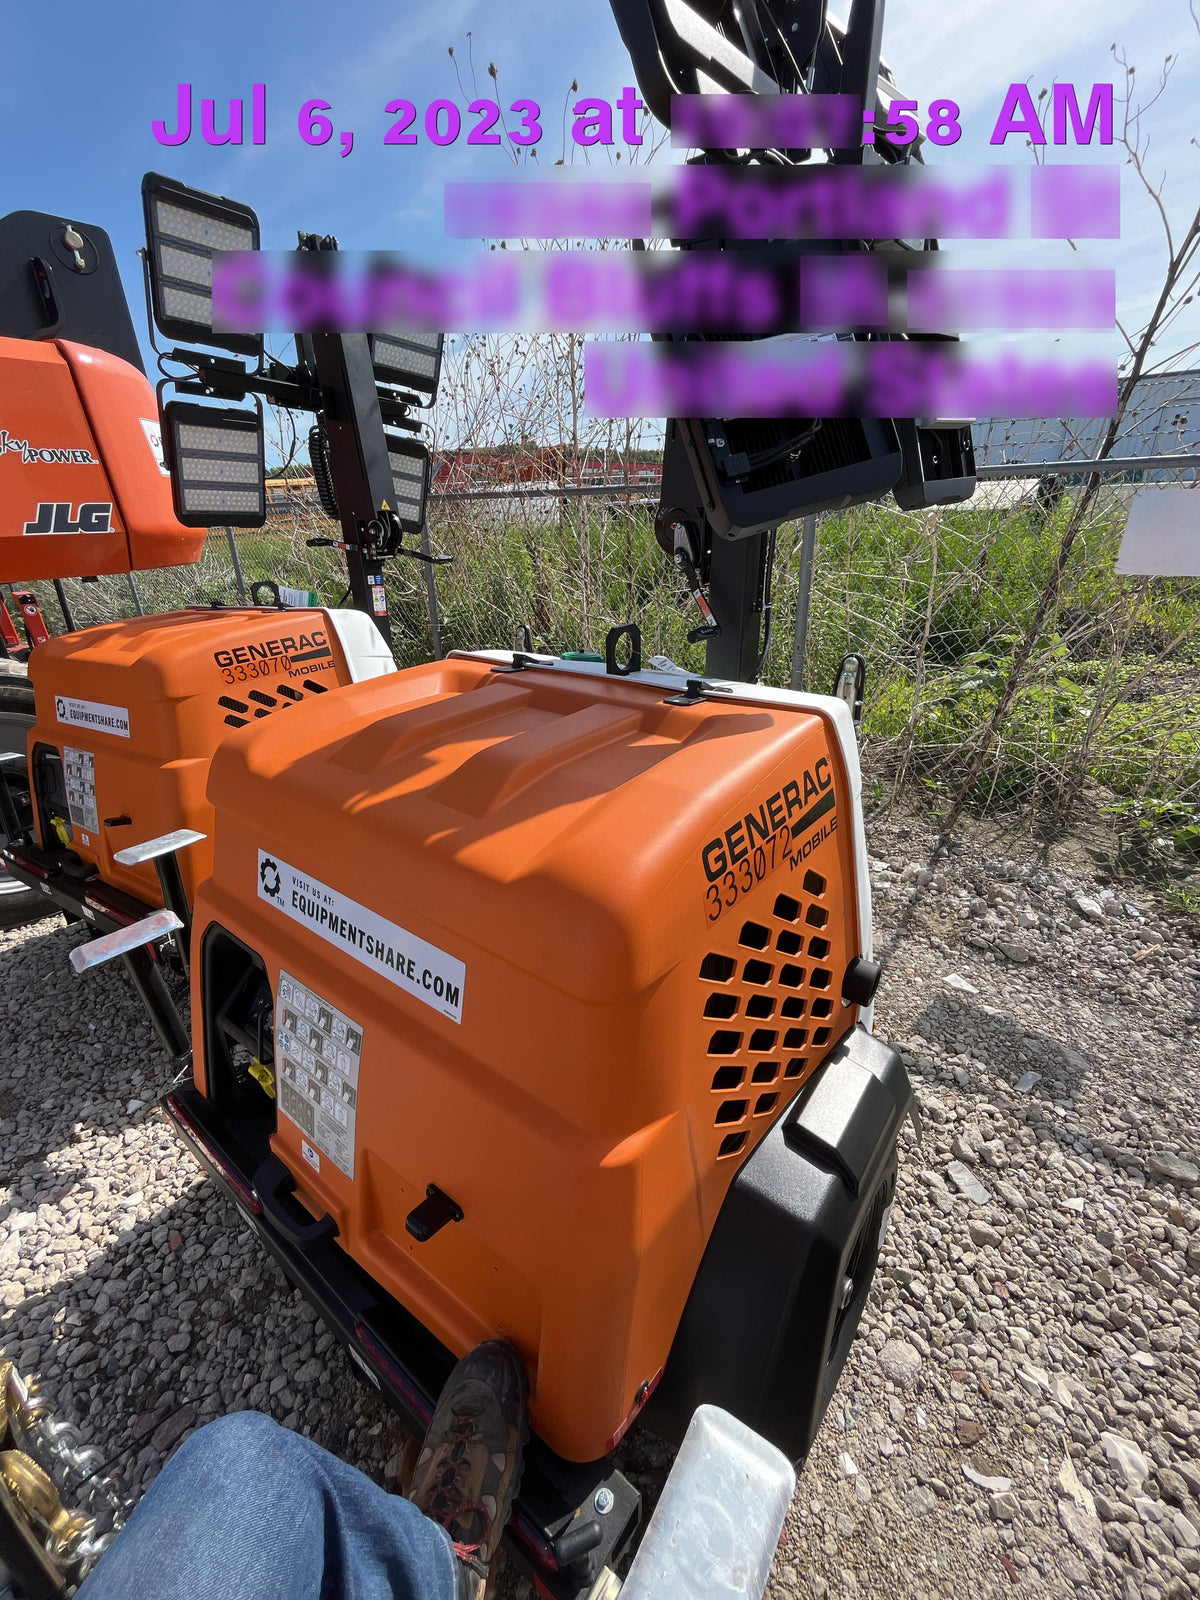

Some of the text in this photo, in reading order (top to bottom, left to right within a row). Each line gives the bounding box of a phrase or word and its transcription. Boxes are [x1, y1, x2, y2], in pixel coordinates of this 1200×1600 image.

[0, 430, 98, 464] kyPOWER
[23, 503, 113, 535] JLG
[213, 631, 327, 667] GENERAC
[221, 655, 292, 685] 333070
[288, 660, 336, 678] MOBILE
[69, 709, 129, 731] EQUIPMENTSHARE.COM
[701, 757, 832, 883] GENERAC
[789, 816, 838, 871] MOBILE
[706, 825, 792, 921] 333072
[292, 876, 334, 906] VISIT US AT:
[291, 890, 460, 1008] EQUIPMENTSHARE.COM
